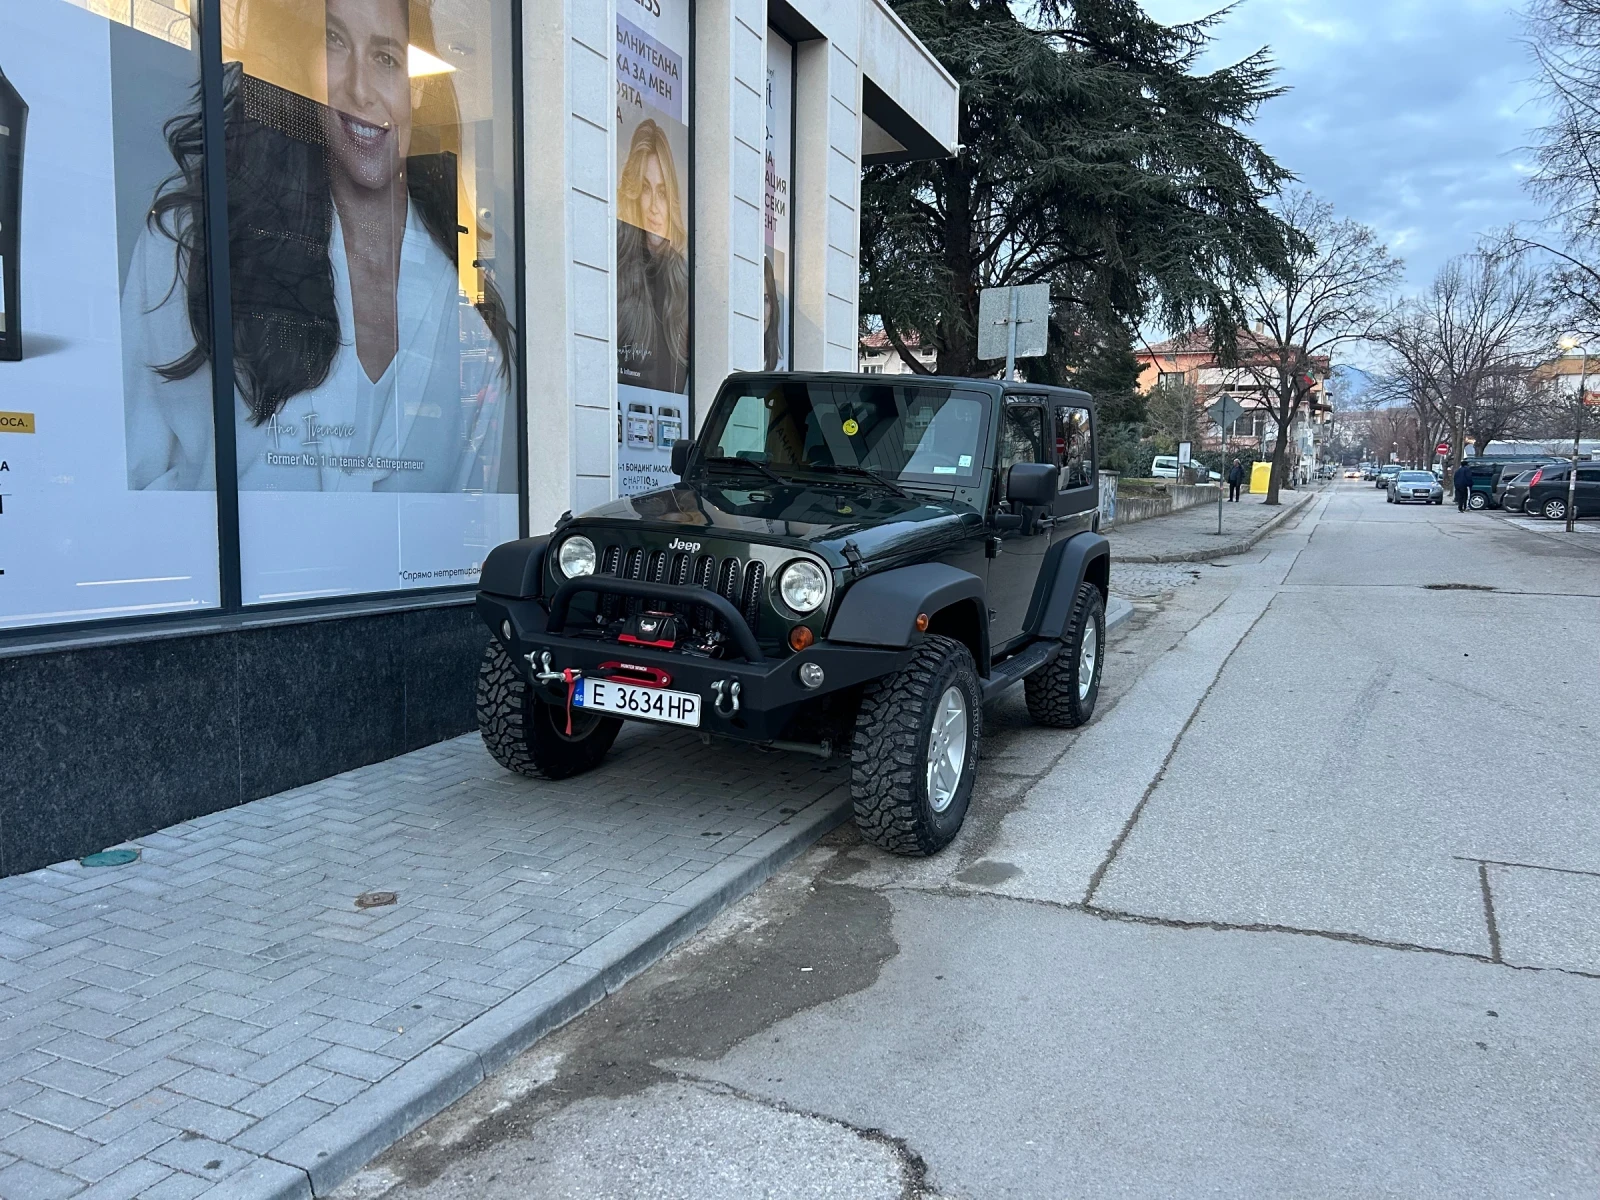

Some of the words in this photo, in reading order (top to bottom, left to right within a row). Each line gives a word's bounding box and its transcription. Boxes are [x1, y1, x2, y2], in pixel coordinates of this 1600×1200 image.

[632, 62, 646, 85] ЗА
[649, 73, 672, 100] МЕН
[267, 413, 298, 449] Ana
[267, 452, 300, 465] Former
[302, 455, 317, 466] No.
[321, 455, 325, 466] 1
[329, 456, 337, 467] in
[339, 456, 365, 468] tennis
[368, 457, 374, 468] &
[376, 457, 424, 471] Entrepreneur
[626, 463, 652, 473] БОНДИНГ
[668, 537, 701, 553] Jeep
[434, 567, 482, 579] нетретиран
[575, 694, 583, 702] BG
[593, 683, 605, 706] E
[616, 687, 663, 716] 3634
[668, 695, 695, 720] HP
